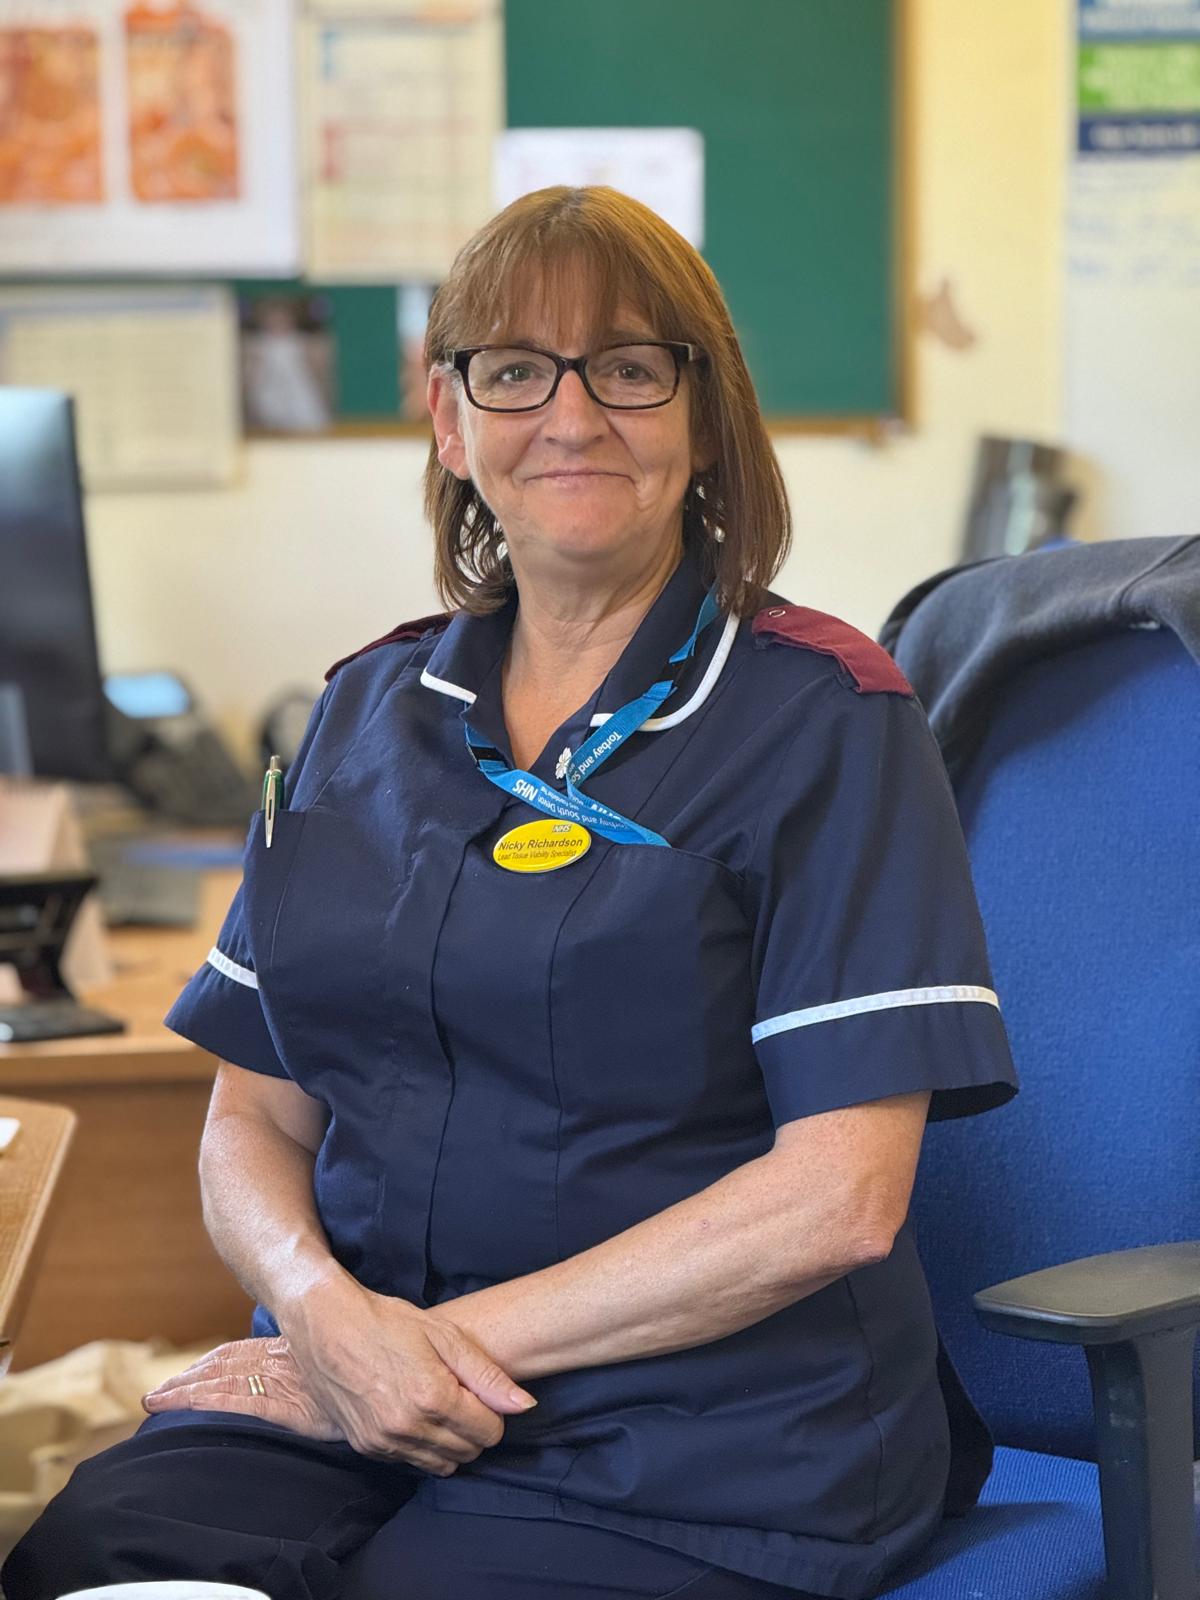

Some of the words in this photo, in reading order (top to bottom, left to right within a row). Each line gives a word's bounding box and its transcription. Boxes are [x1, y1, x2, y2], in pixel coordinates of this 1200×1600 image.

[578, 756, 595, 774] and
[512, 779, 538, 801] NHS
[556, 806, 580, 821] South
[499, 842, 525, 852] Nicky
[527, 838, 583, 848] Richardson
[551, 850, 577, 858] Specialist
